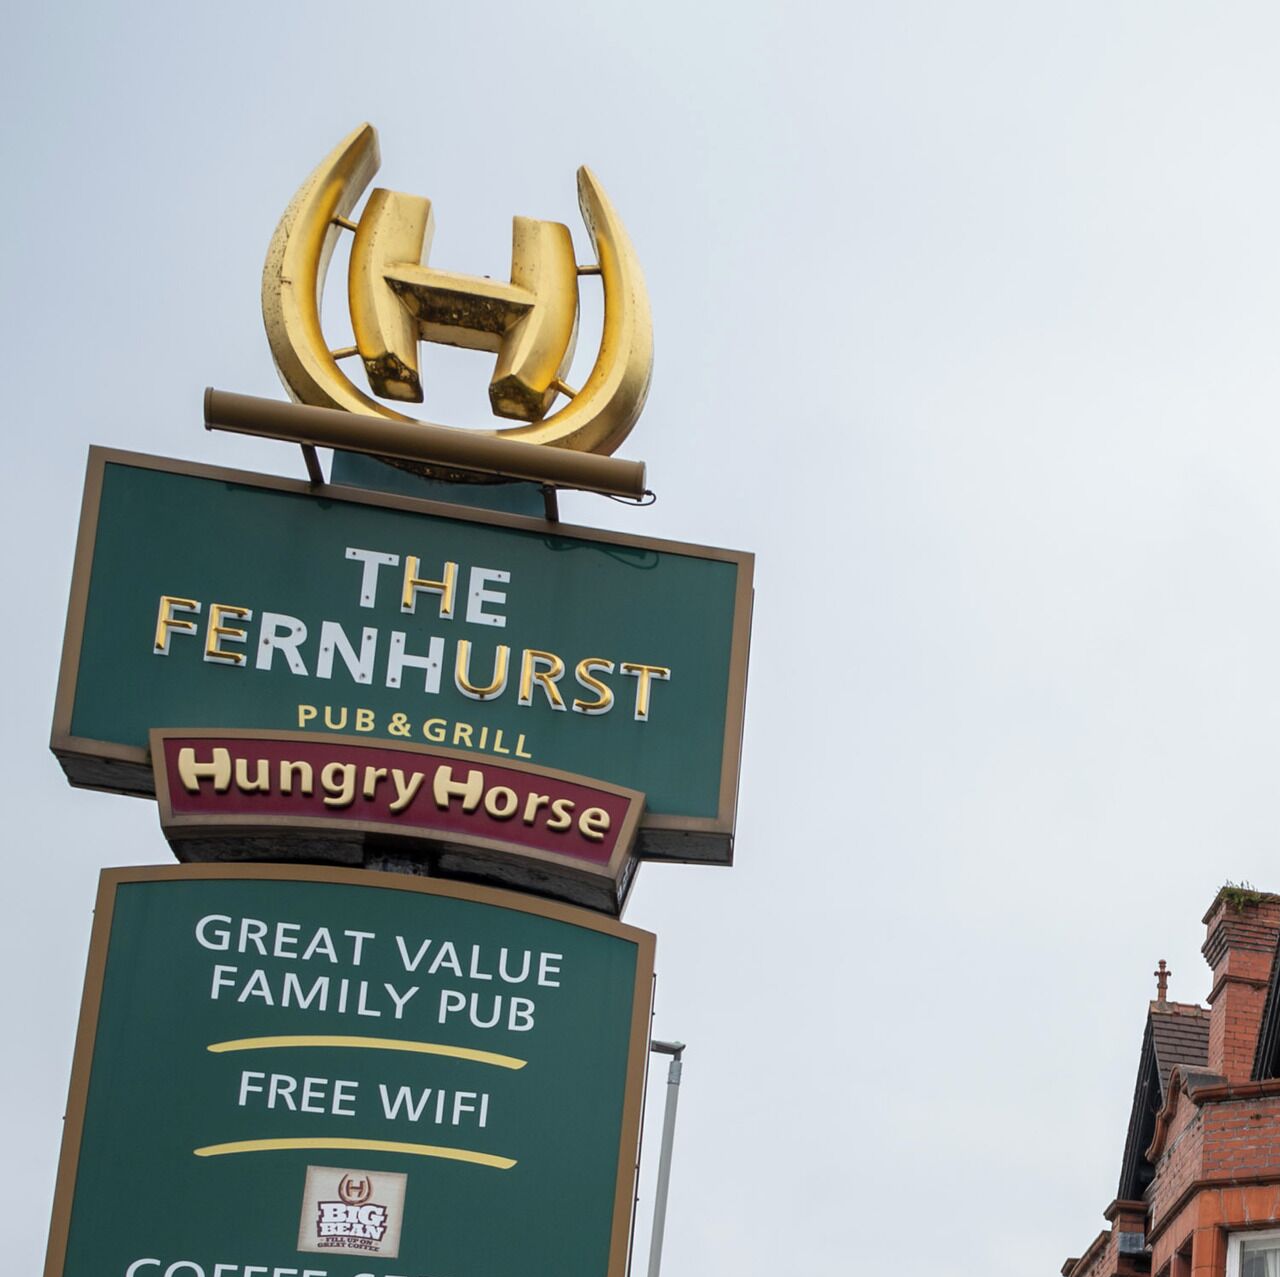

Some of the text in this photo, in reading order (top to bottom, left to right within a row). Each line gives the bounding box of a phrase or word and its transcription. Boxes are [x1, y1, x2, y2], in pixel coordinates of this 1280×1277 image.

[345, 547, 511, 627] THE
[153, 595, 671, 722] FERNHURST
[298, 704, 532, 759] PUB & GRILL
[177, 747, 612, 842] Hungry Horse
[195, 914, 563, 988] GREAT VALUE
[210, 964, 536, 1033] FAMILY PUB
[238, 1071, 491, 1128] FREE WIFI
[319, 1222, 384, 1240] BEAN
[320, 1203, 384, 1226] BIG
